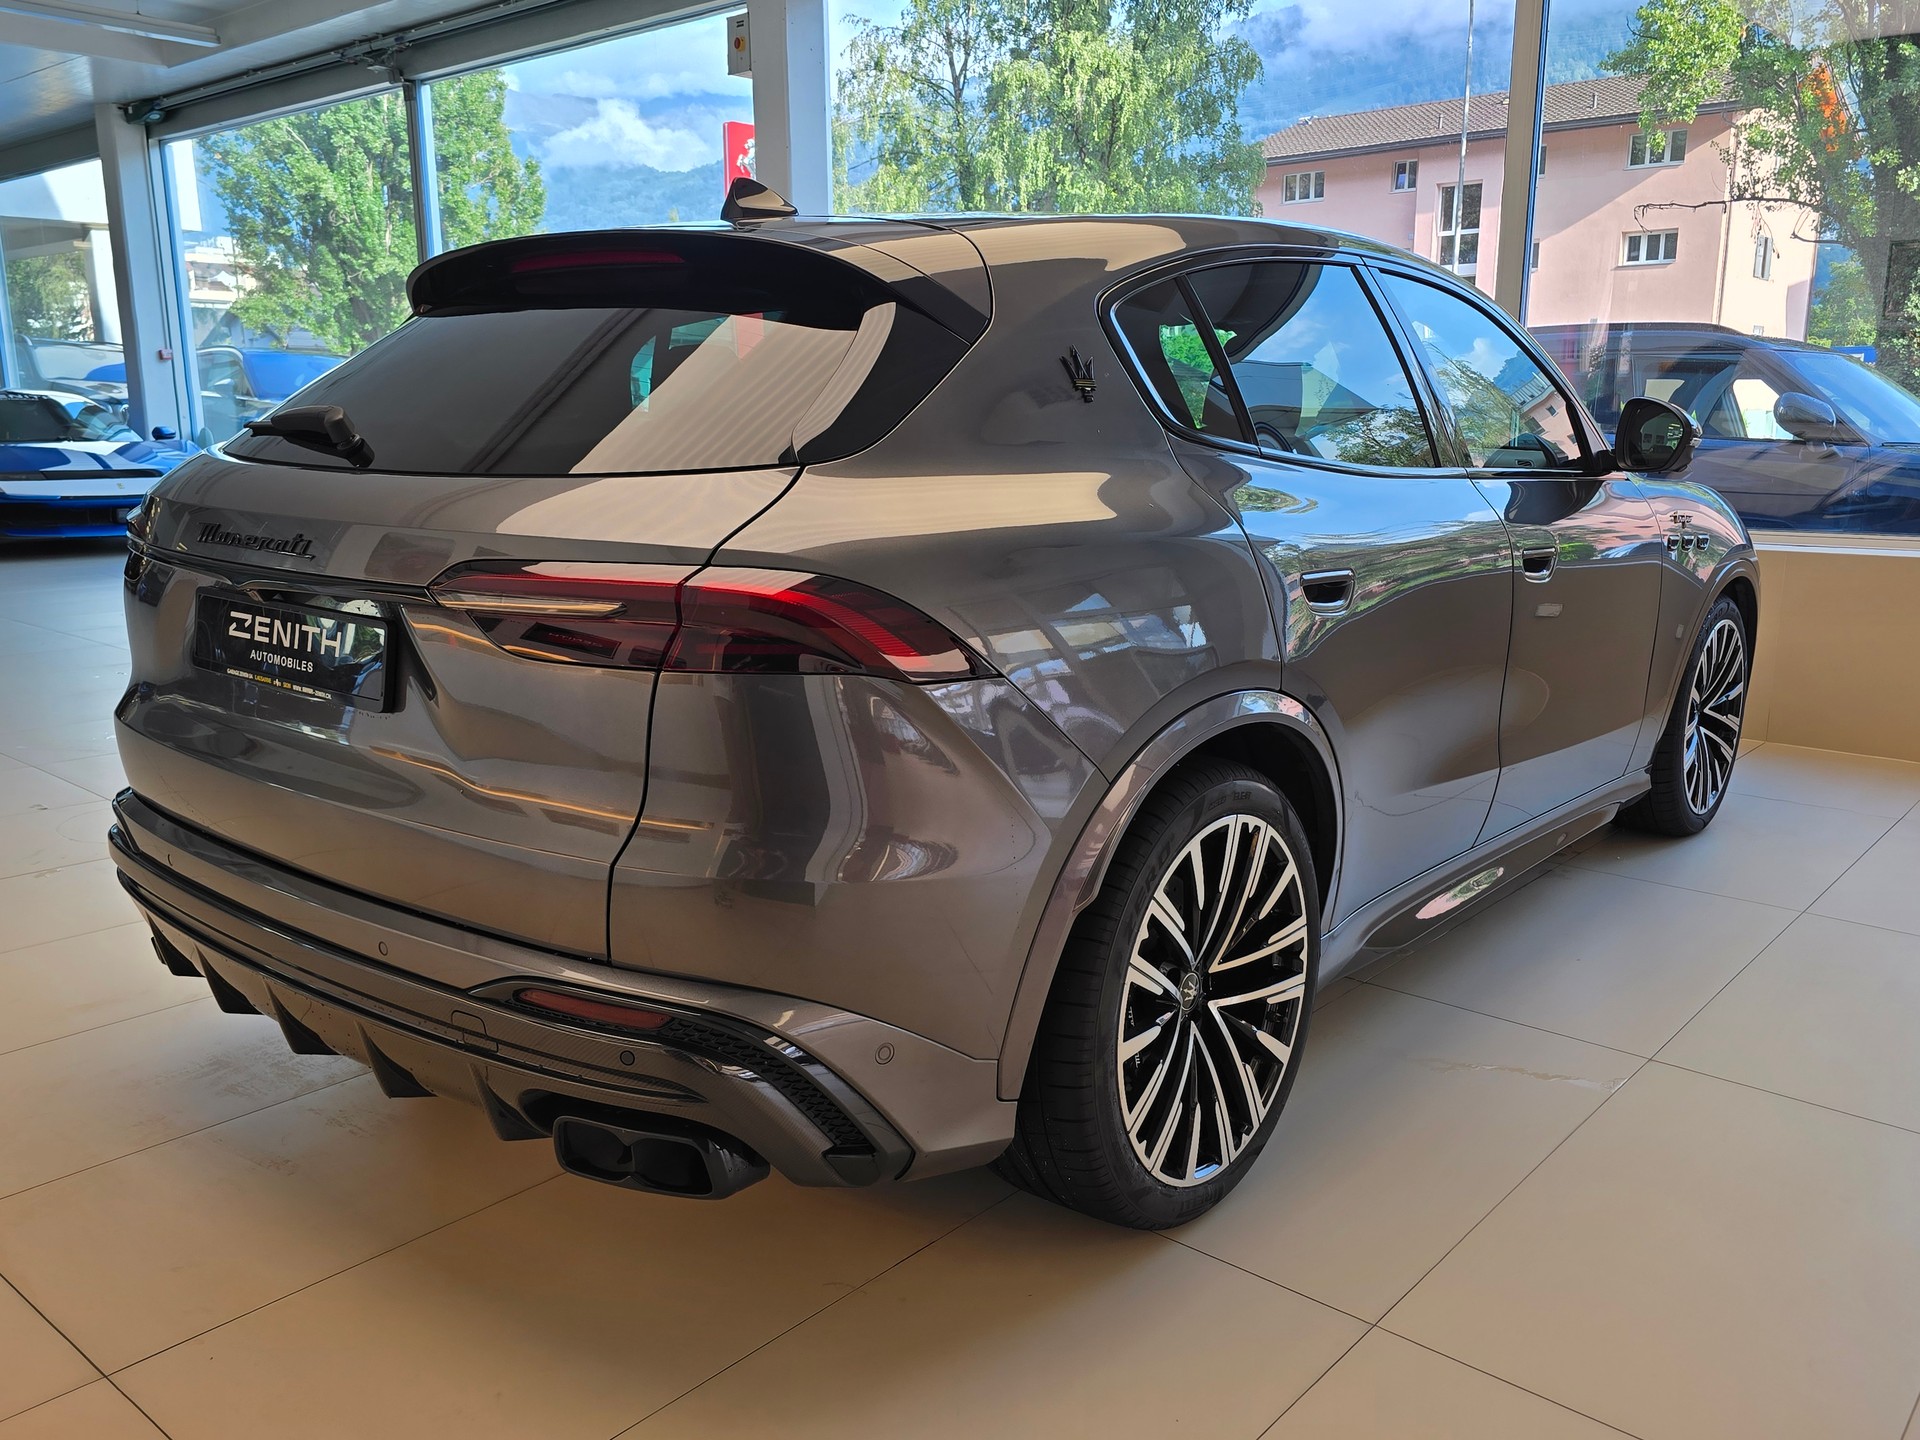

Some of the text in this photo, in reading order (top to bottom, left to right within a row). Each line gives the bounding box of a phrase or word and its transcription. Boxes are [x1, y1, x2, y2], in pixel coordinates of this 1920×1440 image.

[196, 521, 317, 561] Maserati
[228, 610, 343, 658] ZENITH
[249, 648, 314, 673] AUTOMOBILES
